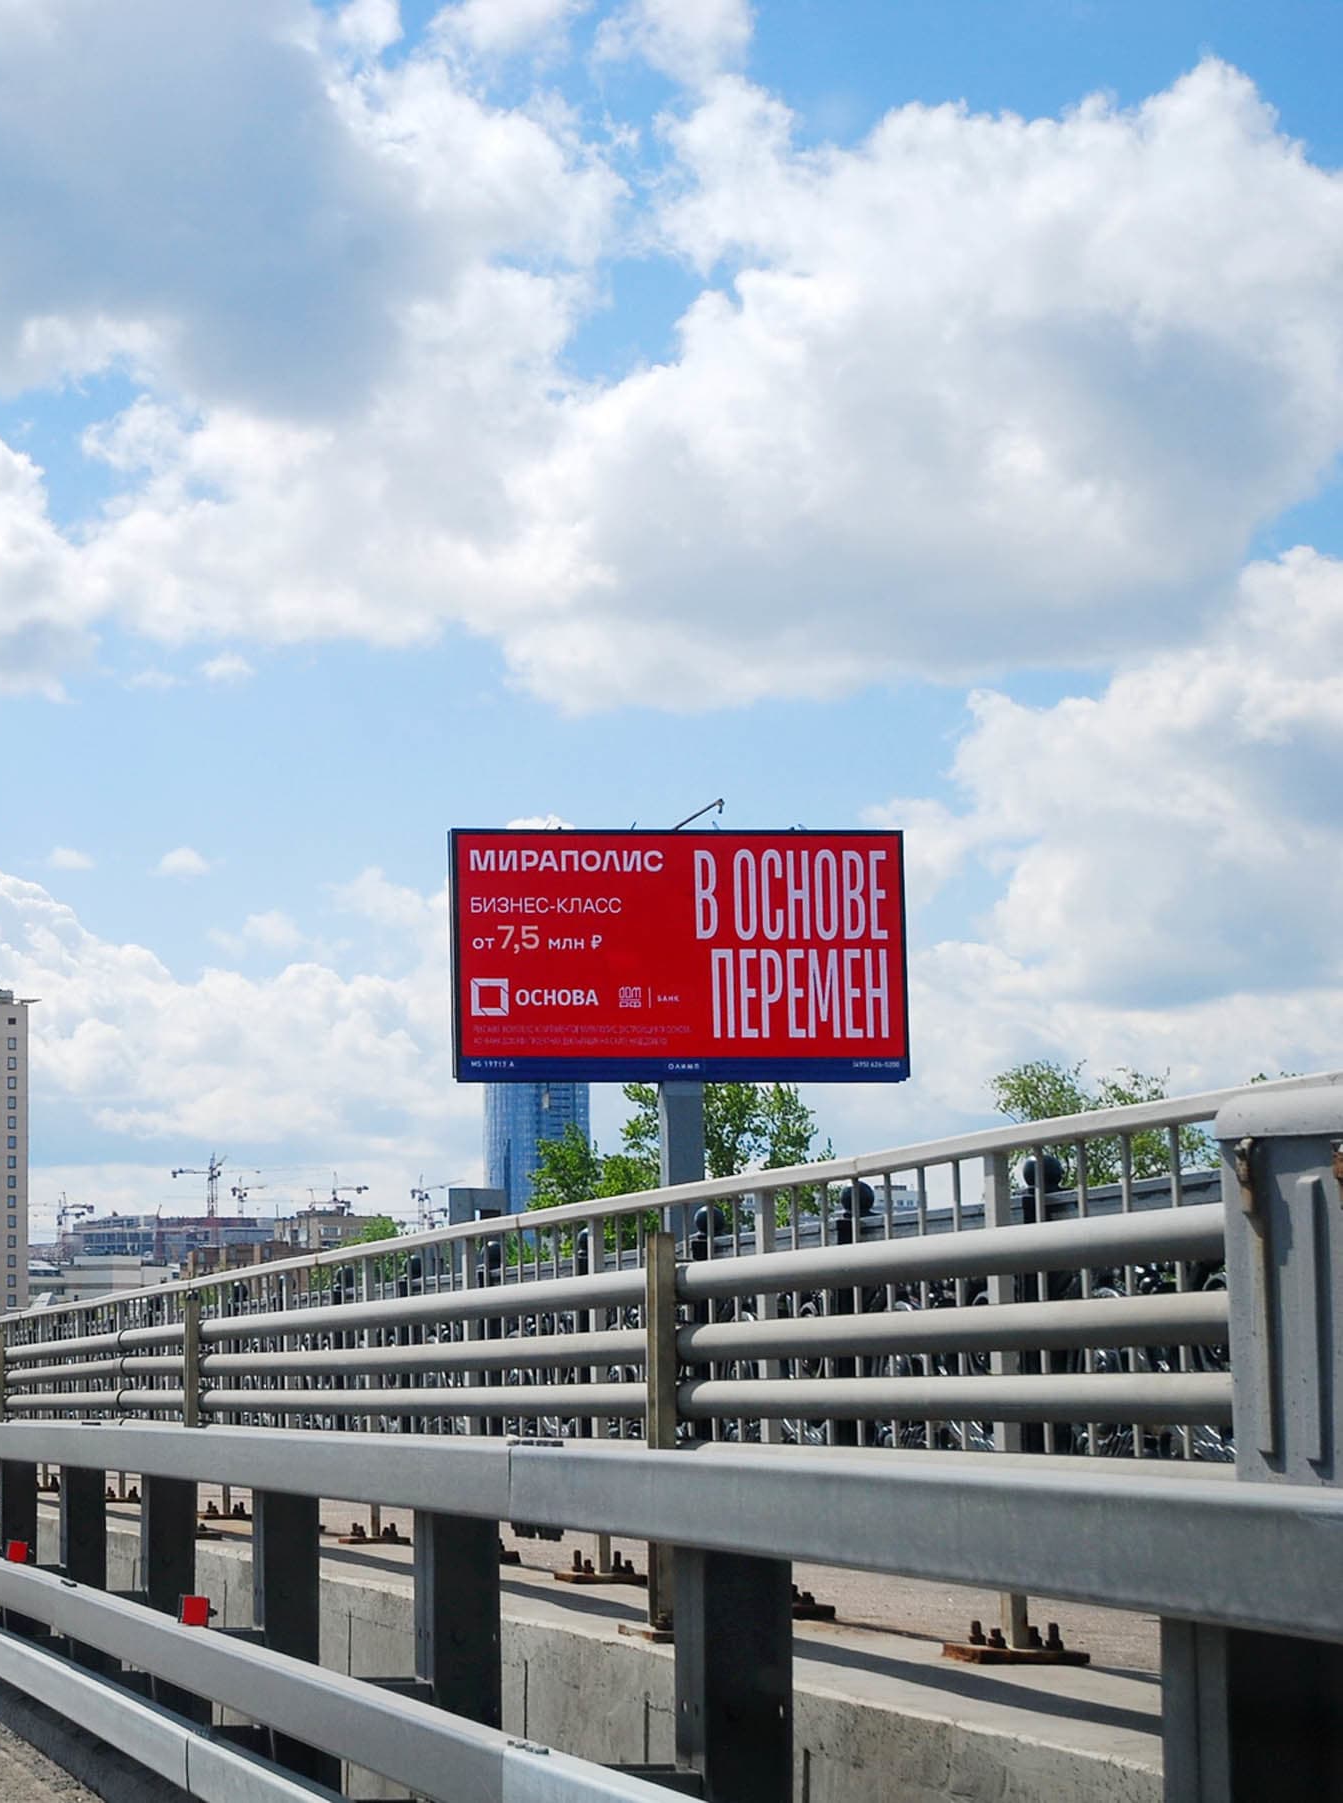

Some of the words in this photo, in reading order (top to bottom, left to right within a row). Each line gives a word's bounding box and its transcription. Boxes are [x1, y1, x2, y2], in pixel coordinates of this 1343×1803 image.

[469, 849, 664, 872] МИРАПОЛИС
[470, 897, 622, 914] БИЗНЕС-КЛАСС
[693, 849, 719, 940] В
[732, 848, 889, 941] ОСНОВЕ
[472, 937, 495, 950] от
[497, 925, 540, 954] 7,5
[548, 937, 585, 950] млн
[515, 988, 599, 1006] ОСНОВА
[710, 948, 890, 1039] ПЕРЕМЕН
